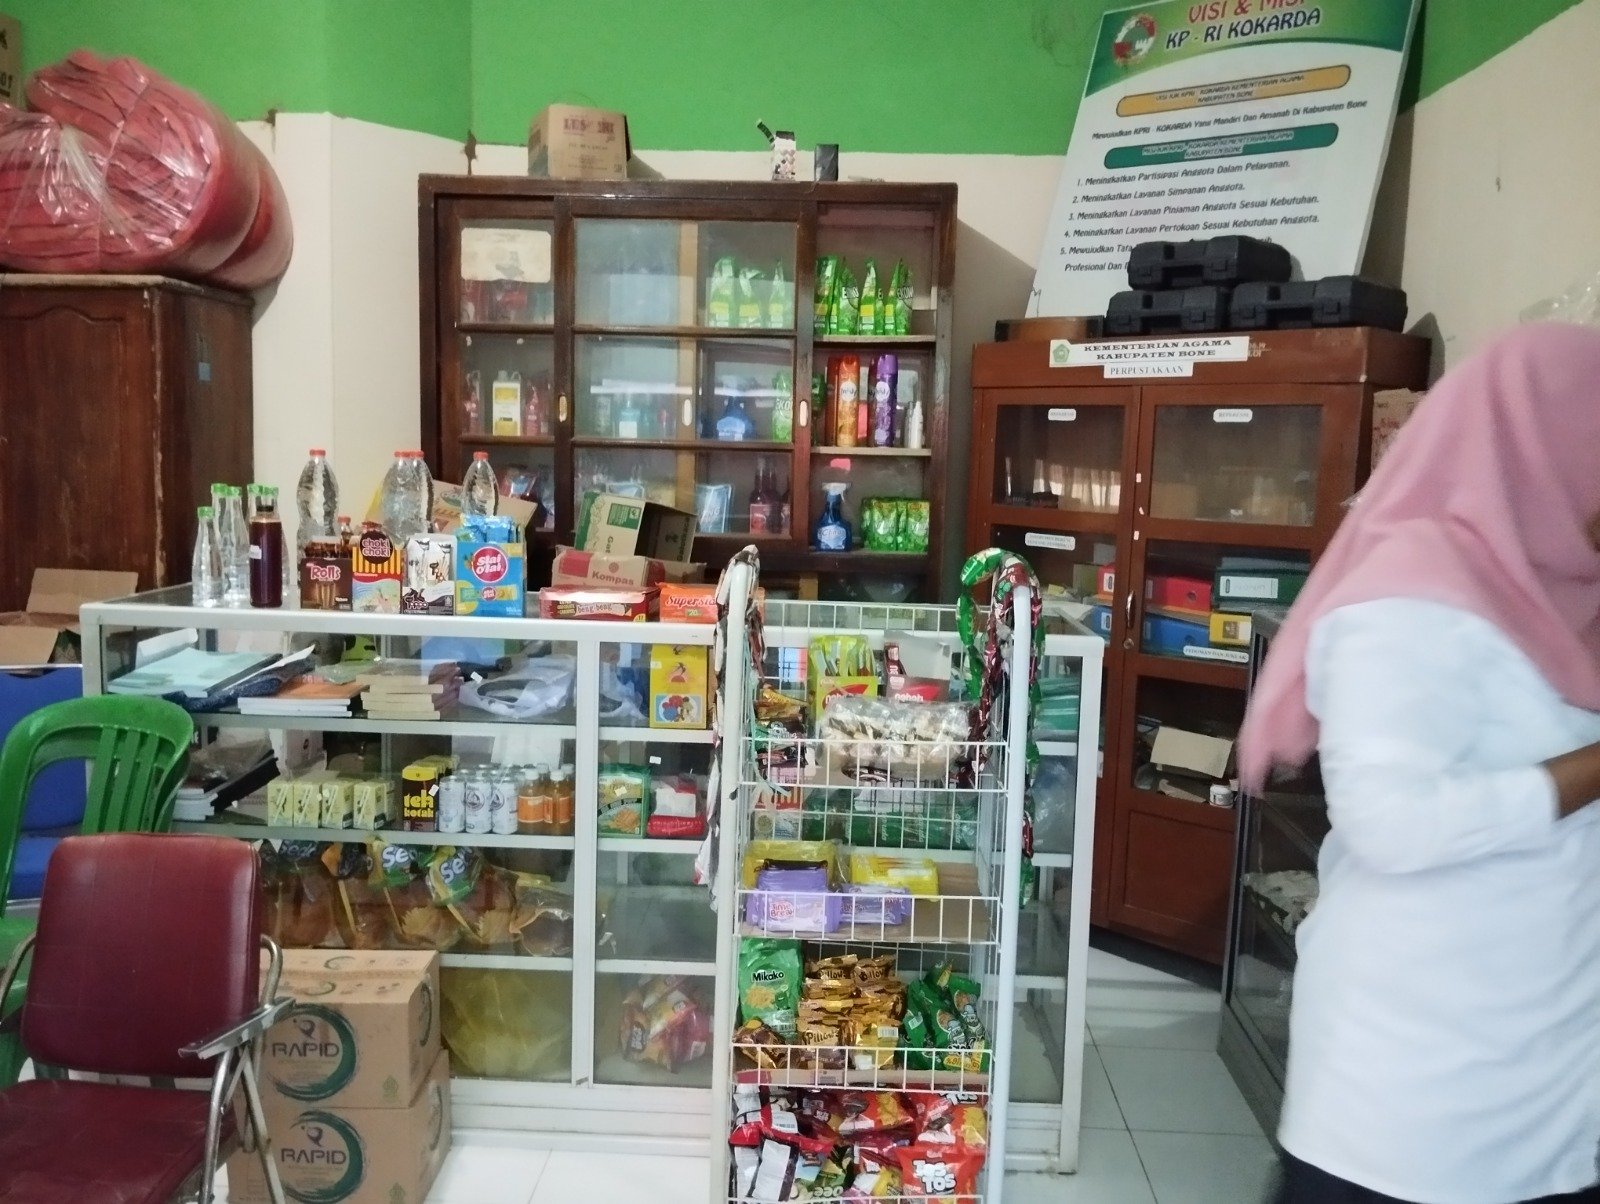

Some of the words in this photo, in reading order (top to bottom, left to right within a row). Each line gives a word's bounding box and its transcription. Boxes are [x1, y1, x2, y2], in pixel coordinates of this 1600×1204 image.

[1166, 30, 1191, 49] KP
[1204, 24, 1223, 42] RI
[1227, 7, 1321, 39] KOKARDA
[1133, 126, 1151, 135] KPRI
[1156, 121, 1192, 132] KOKARDA
[1213, 115, 1241, 126] Mandiri
[1243, 114, 1257, 122] Dan
[1259, 109, 1290, 120] Amanah
[1302, 102, 1344, 114] Kabupaten
[1346, 100, 1367, 109] Bone
[1085, 175, 1136, 186] Meningkatkan
[1137, 171, 1179, 182] Partisipasi
[1181, 167, 1215, 178] Anggota
[1217, 164, 1243, 174] Dalam
[1245, 160, 1291, 171] Pelayanan.
[1081, 192, 1132, 203] Meningkatkan
[1133, 189, 1166, 200] Layanan
[1167, 186, 1207, 197] Simpanan
[1077, 209, 1128, 220] Meningkatkan
[1129, 207, 1162, 217] Layanan
[1163, 204, 1201, 215] Pinjaman
[1202, 202, 1237, 212] Anggota
[1239, 199, 1268, 209] Sesuai
[1073, 227, 1124, 238] Meningkatkan
[1125, 225, 1158, 235] Layanan
[1159, 222, 1200, 233] Pertokoan
[1202, 220, 1230, 231] Sesuai
[1232, 217, 1278, 228] Kebutuhan
[1069, 244, 1115, 255] Mewujudkan
[1064, 261, 1106, 272] Profesional
[1107, 260, 1122, 271] Dan
[1084, 341, 1179, 352] KEMENTERIAN
[1182, 339, 1232, 348] AGAMA
[1096, 351, 1176, 360] KABUPATEN
[1178, 349, 1216, 357] BONE
[1110, 365, 1184, 375] PERPUSTAKAAN
[361, 538, 391, 548] choki
[361, 547, 391, 557] choki
[310, 564, 342, 581] Rolls
[591, 569, 635, 586] Kompas
[665, 594, 718, 609] Supersta
[403, 789, 434, 808] teh
[752, 970, 784, 982] Mikako
[272, 1042, 339, 1058] RAPID
[280, 1148, 347, 1165] RAPID
